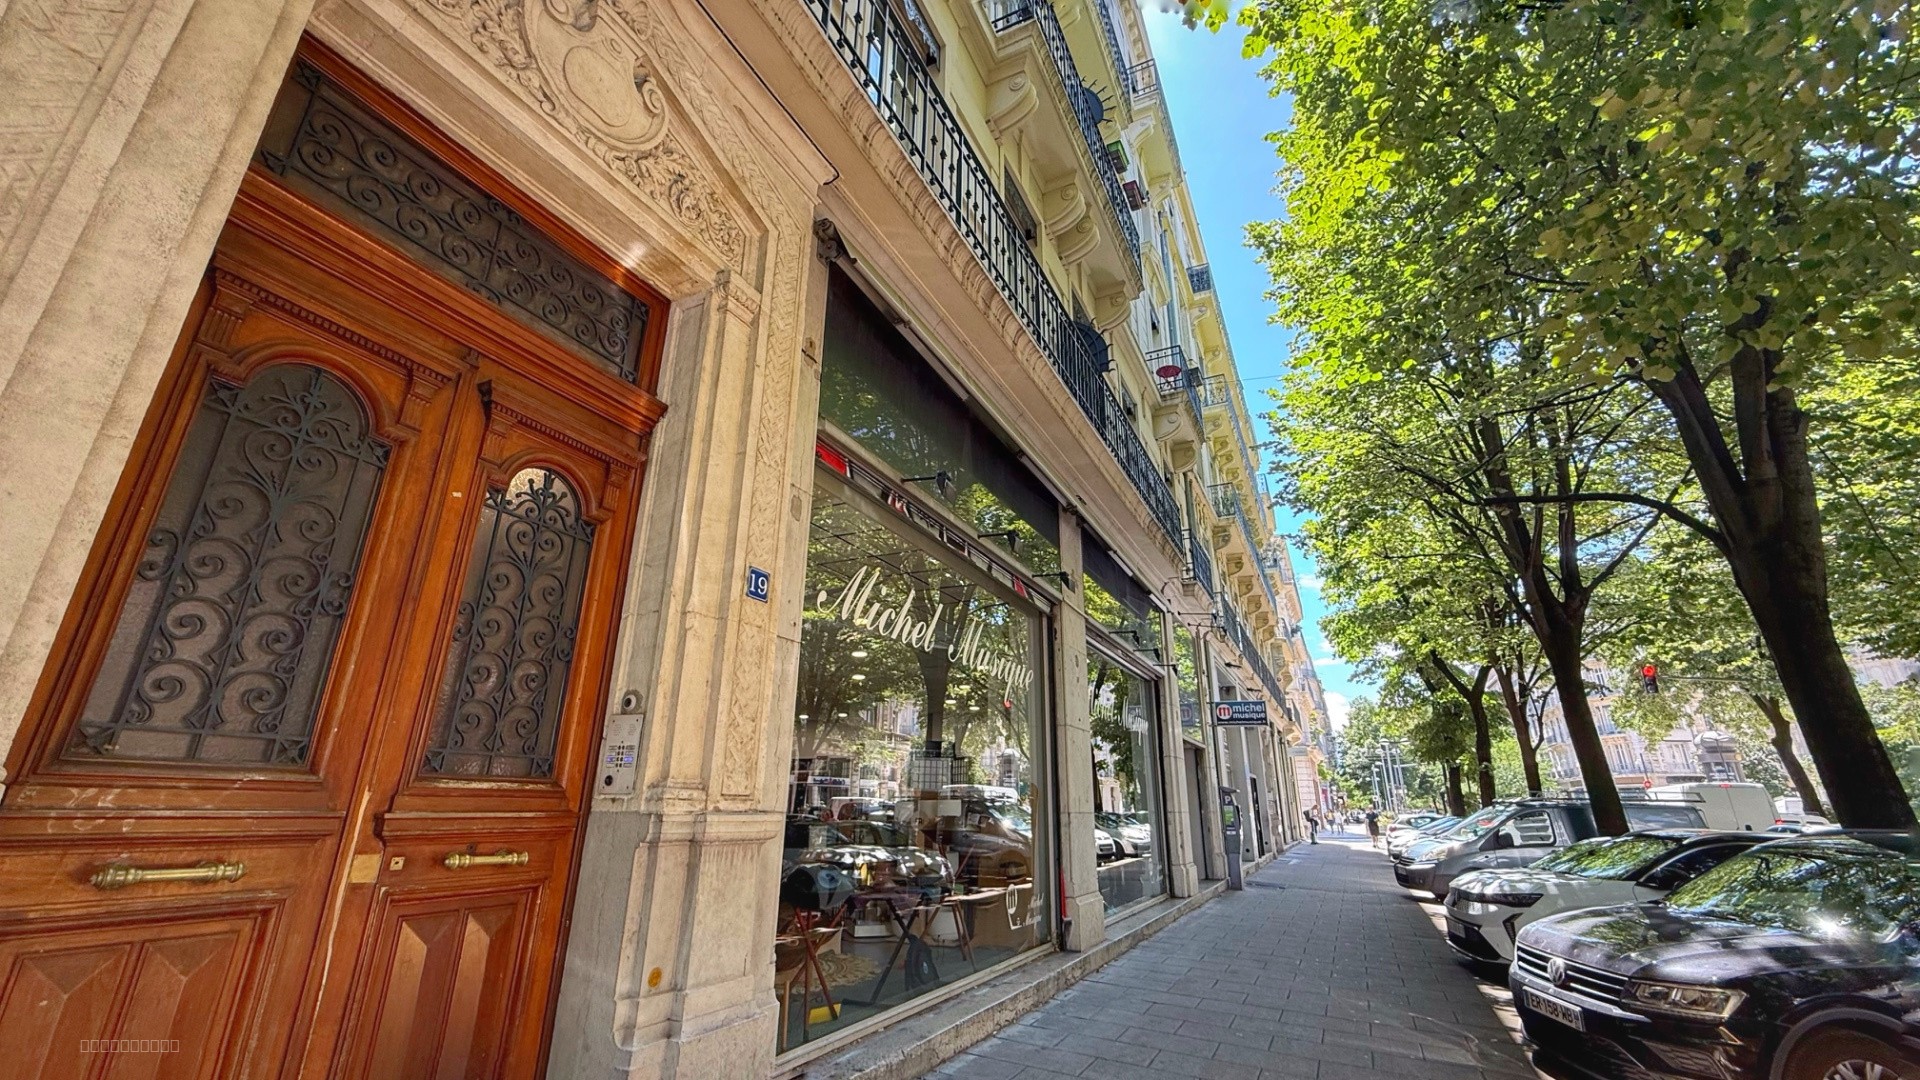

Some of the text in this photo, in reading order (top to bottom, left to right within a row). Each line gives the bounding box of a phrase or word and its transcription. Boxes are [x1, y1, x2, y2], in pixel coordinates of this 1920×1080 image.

[749, 573, 768, 595] 19
[817, 565, 1034, 706] Michel Musique
[1218, 707, 1231, 717] m
[1232, 702, 1266, 713] michel
[1232, 711, 1266, 720] musique
[1224, 795, 1232, 804] P
